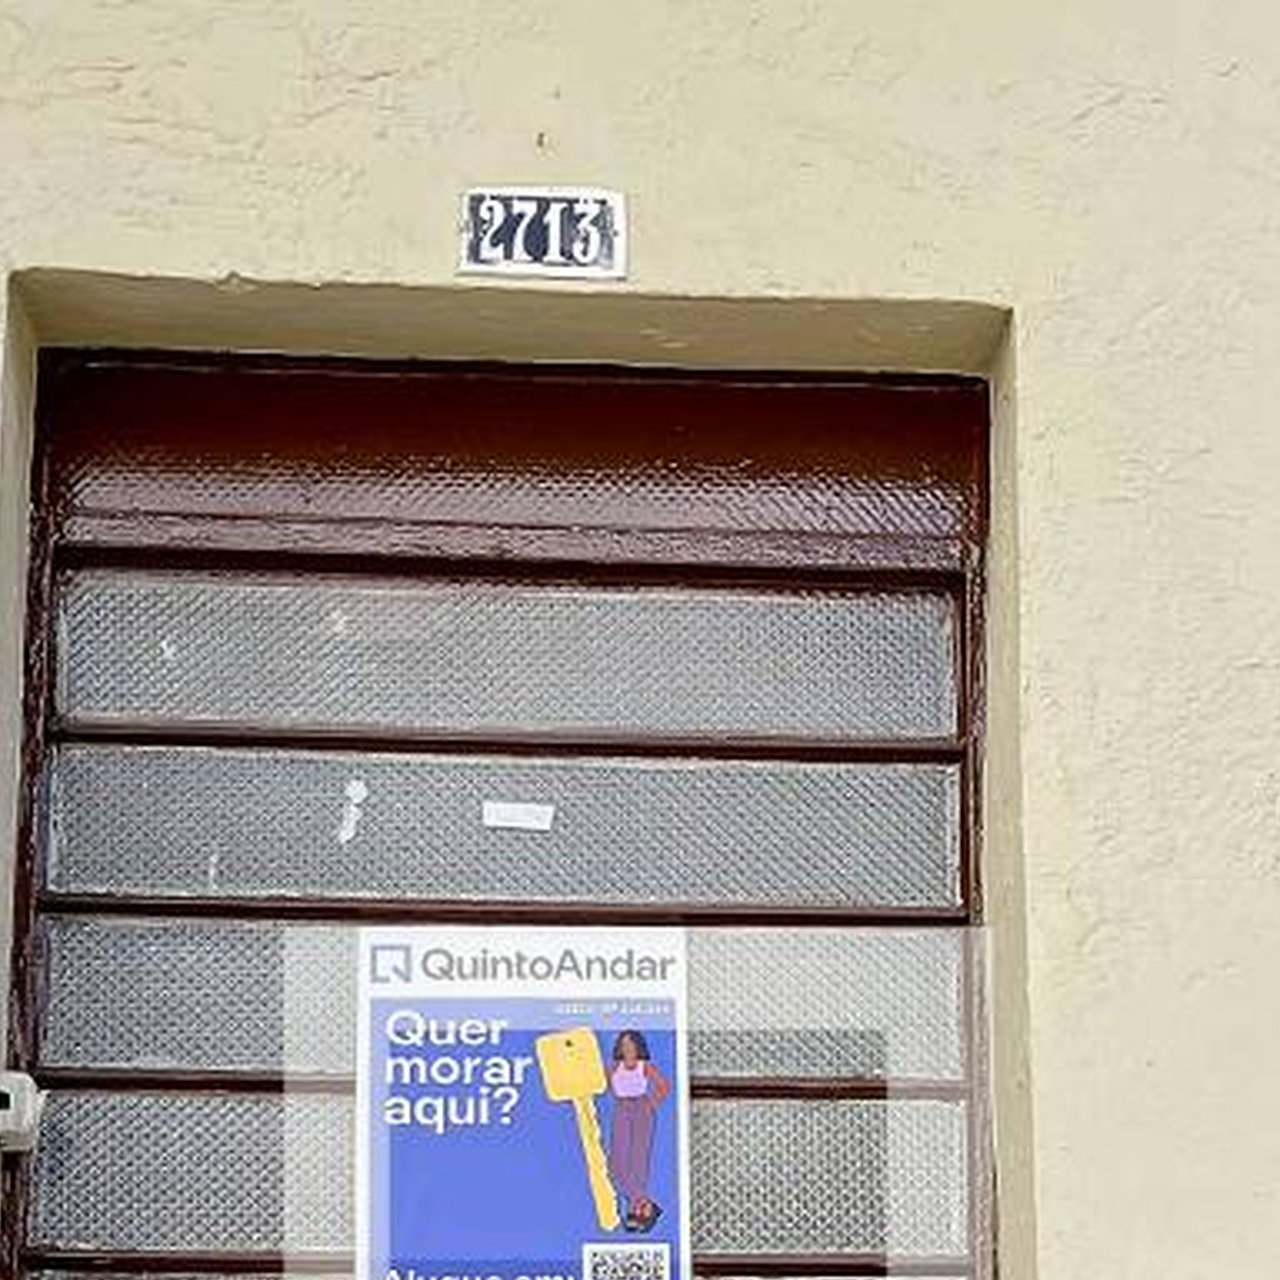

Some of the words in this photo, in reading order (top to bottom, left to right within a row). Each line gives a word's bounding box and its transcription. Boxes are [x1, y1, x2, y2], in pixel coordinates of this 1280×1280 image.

[478, 198, 603, 265] 2713
[421, 948, 676, 982] QuintoAndar
[385, 1010, 508, 1046] Quer
[385, 1053, 533, 1084] morar
[384, 1086, 520, 1133] aqui?
